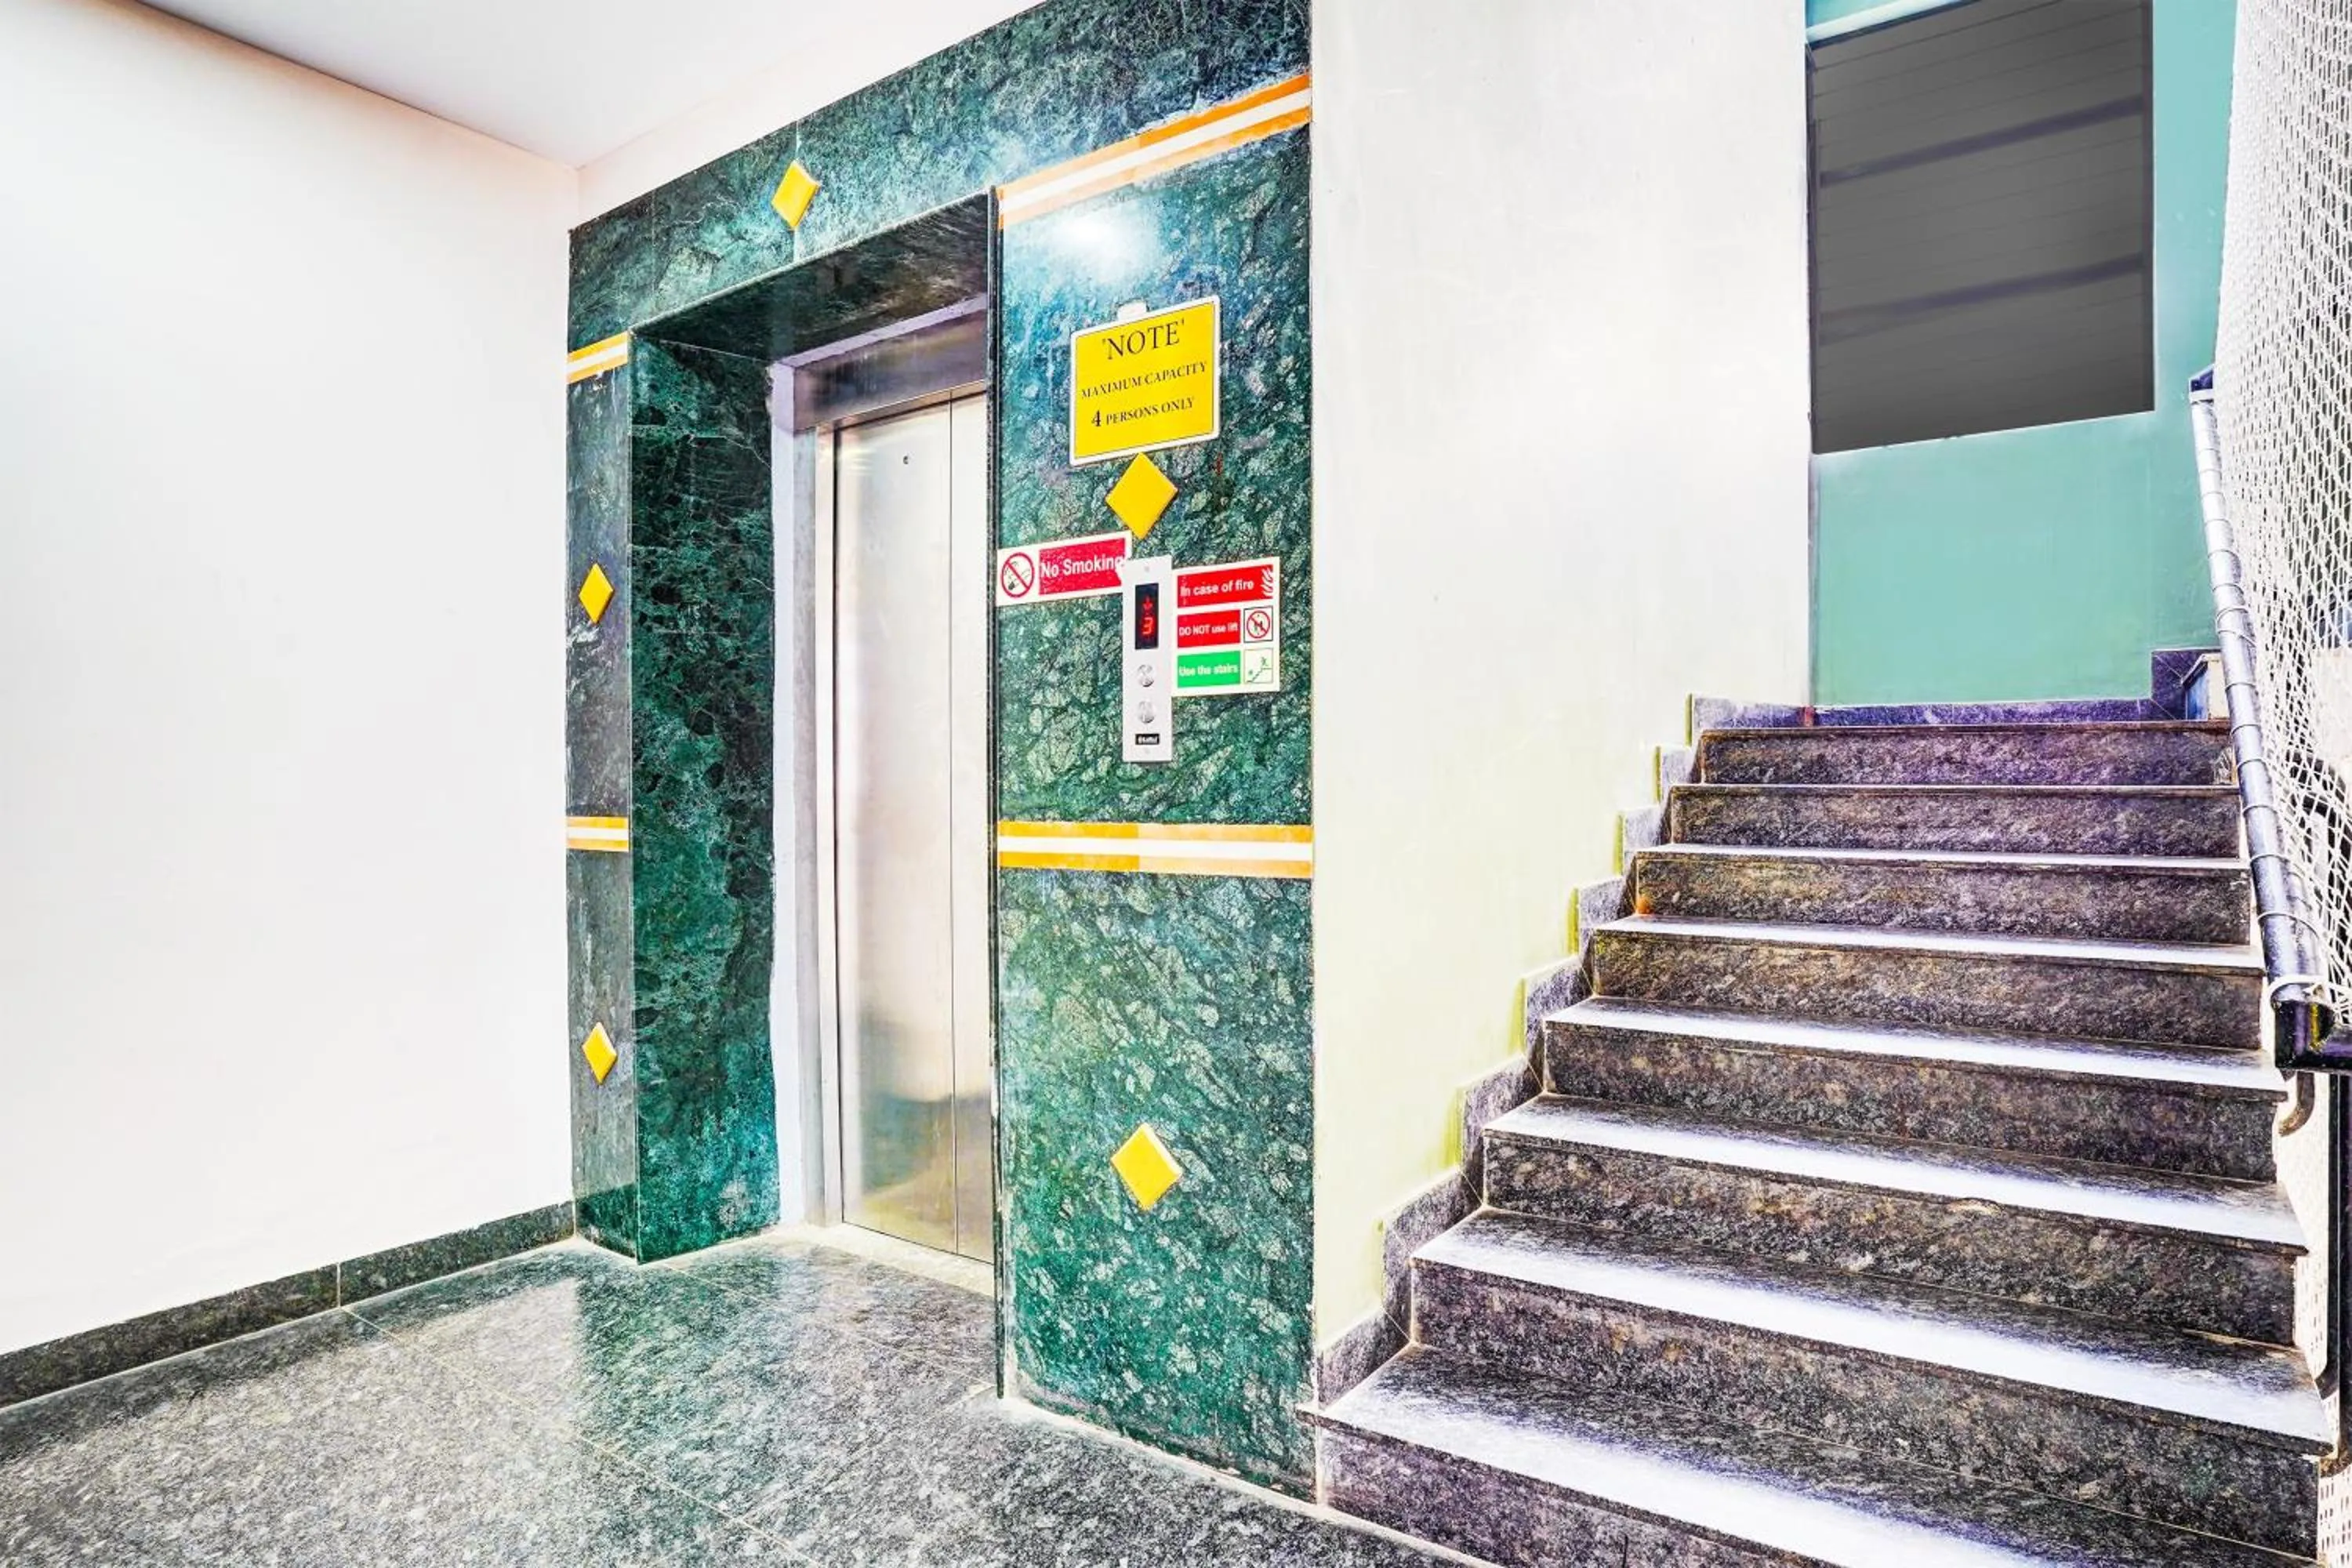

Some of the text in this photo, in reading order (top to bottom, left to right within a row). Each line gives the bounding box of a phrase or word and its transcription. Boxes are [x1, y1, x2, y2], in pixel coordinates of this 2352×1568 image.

[1081, 361, 1207, 399] MAXIMUM CAPACITY
[1091, 396, 1195, 427] 4 PERSONS ONLY
[1040, 561, 1059, 578] No
[1180, 579, 1254, 597] In case of fire
[1142, 616, 1154, 635] 3
[1179, 626, 1192, 636] DO
[1192, 624, 1210, 634] NOT
[1179, 663, 1238, 677] Use the stairs
